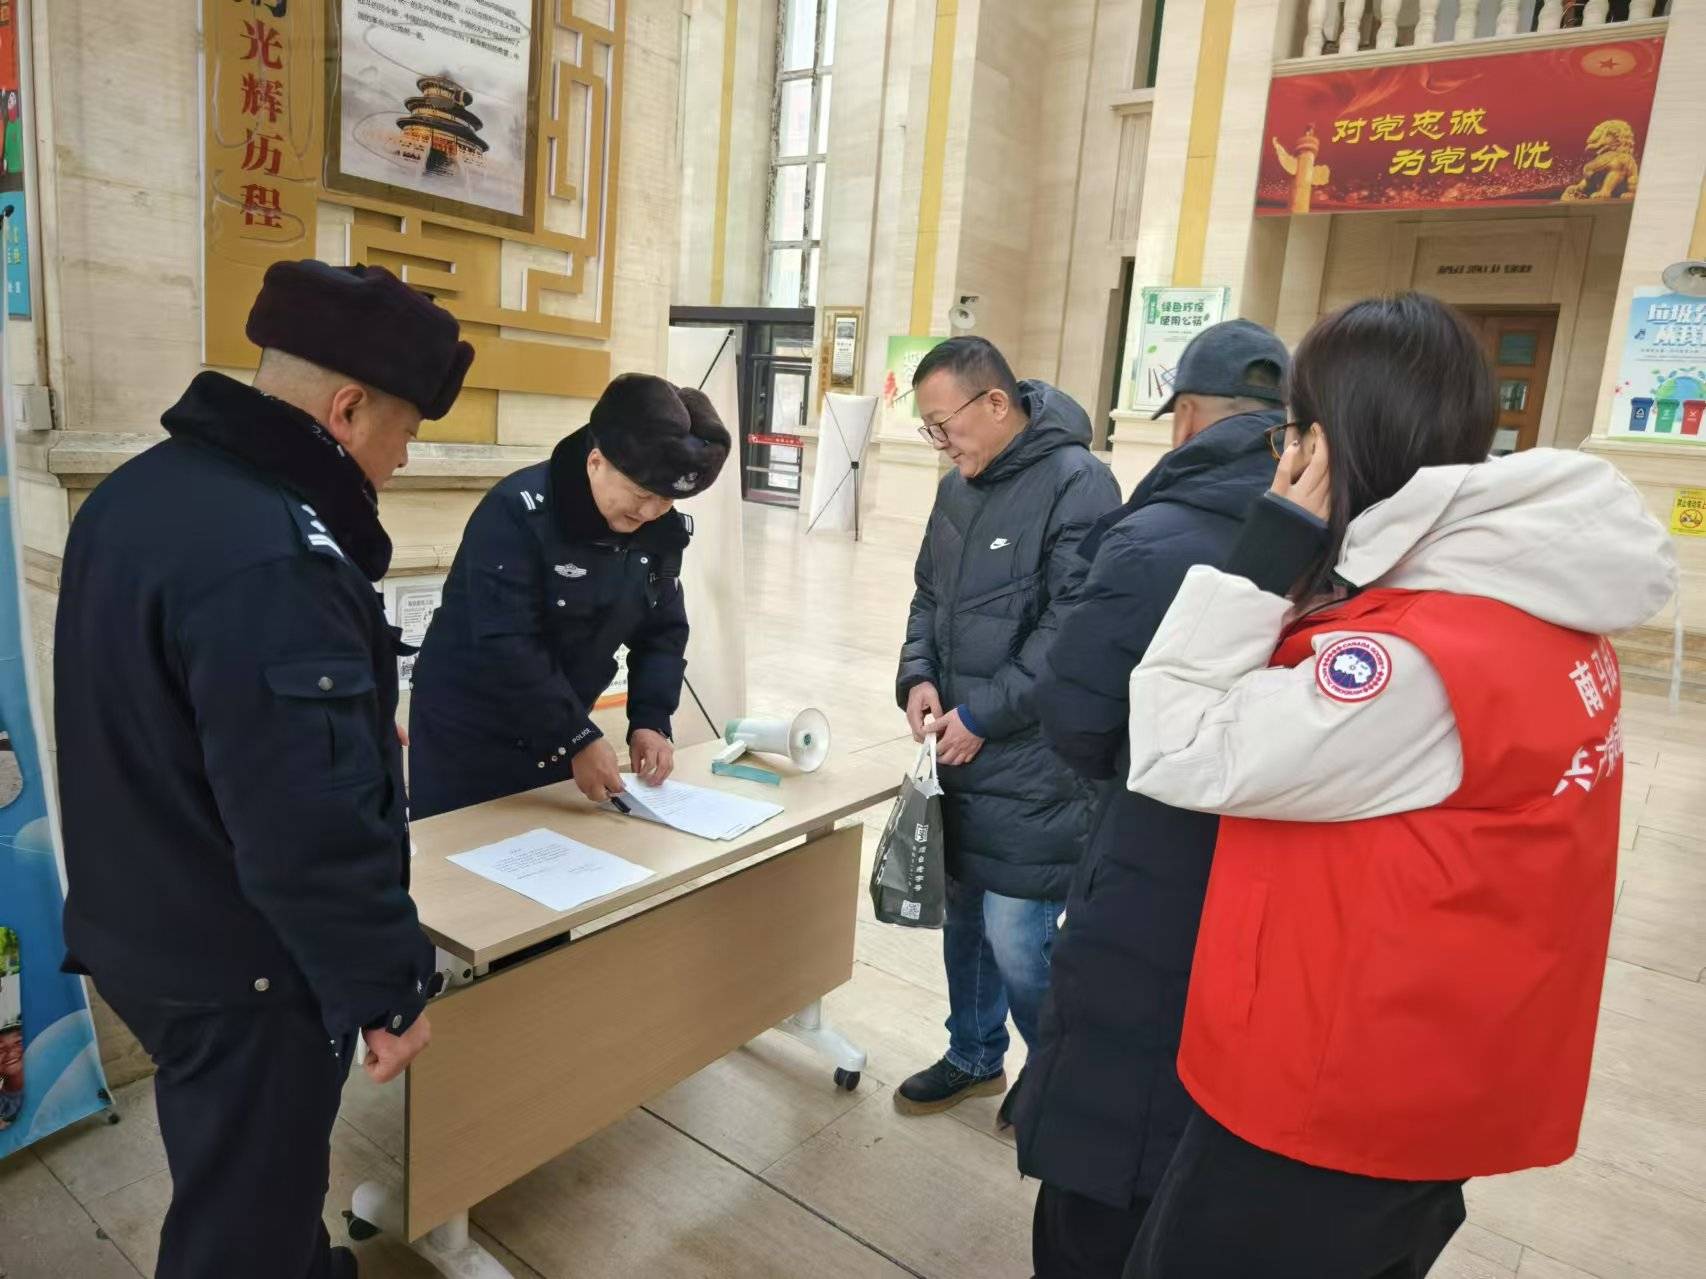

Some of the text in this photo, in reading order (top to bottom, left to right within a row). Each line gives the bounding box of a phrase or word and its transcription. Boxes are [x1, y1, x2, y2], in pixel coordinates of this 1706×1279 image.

[1332, 108, 1488, 144] 对党忠诚
[1389, 141, 1553, 176] 为党分忧
[1343, 641, 1370, 649] CANADA
[571, 728, 591, 743] POLICE
